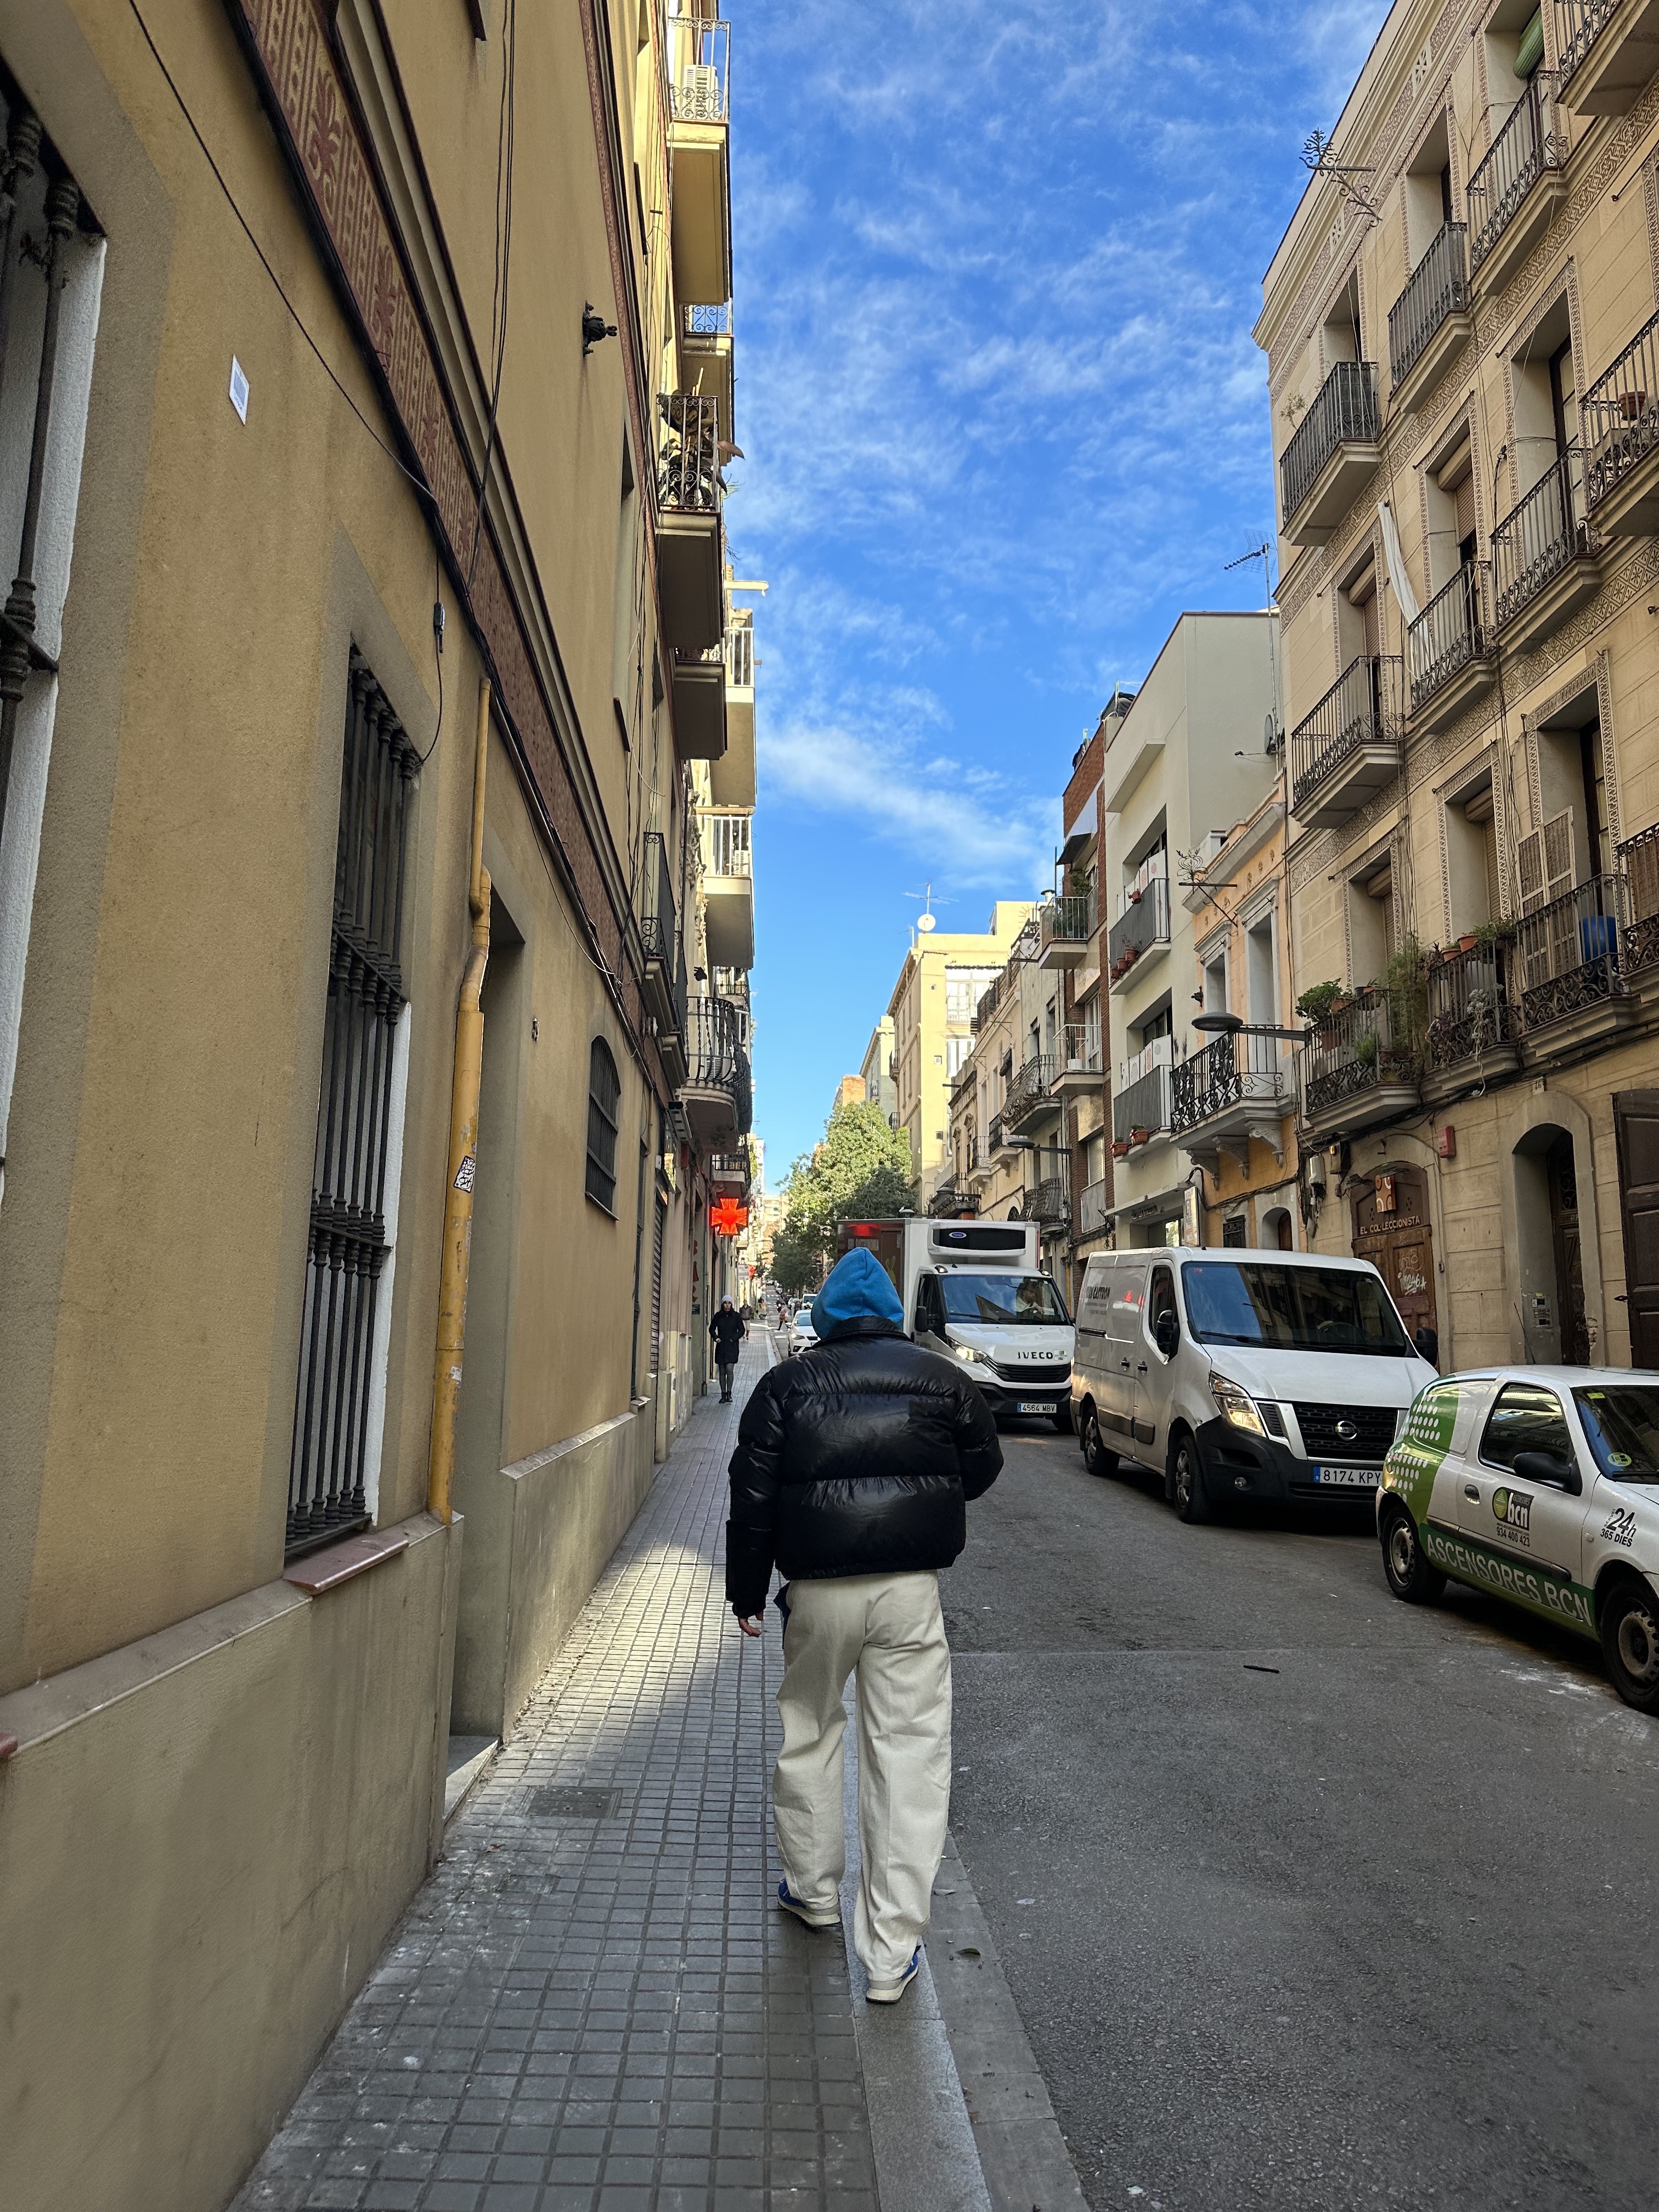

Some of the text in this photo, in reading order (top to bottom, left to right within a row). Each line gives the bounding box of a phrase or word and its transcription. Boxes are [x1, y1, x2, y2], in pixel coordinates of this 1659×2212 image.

[1360, 1226, 1368, 1235] EL
[1017, 1351, 1054, 1359] IVECO
[1022, 1404, 1040, 1412] 4564
[1323, 1470, 1381, 1484] 8174 KPY
[1507, 1492, 1528, 1528] bcn
[1606, 1508, 1637, 1538] 24h
[1496, 1526, 1507, 1539] 934
[1508, 1530, 1518, 1543] 400
[1519, 1535, 1530, 1547] 423
[1600, 1528, 1633, 1548] 365 DIES
[1427, 1533, 1593, 1627] ASCENSORES BCN
